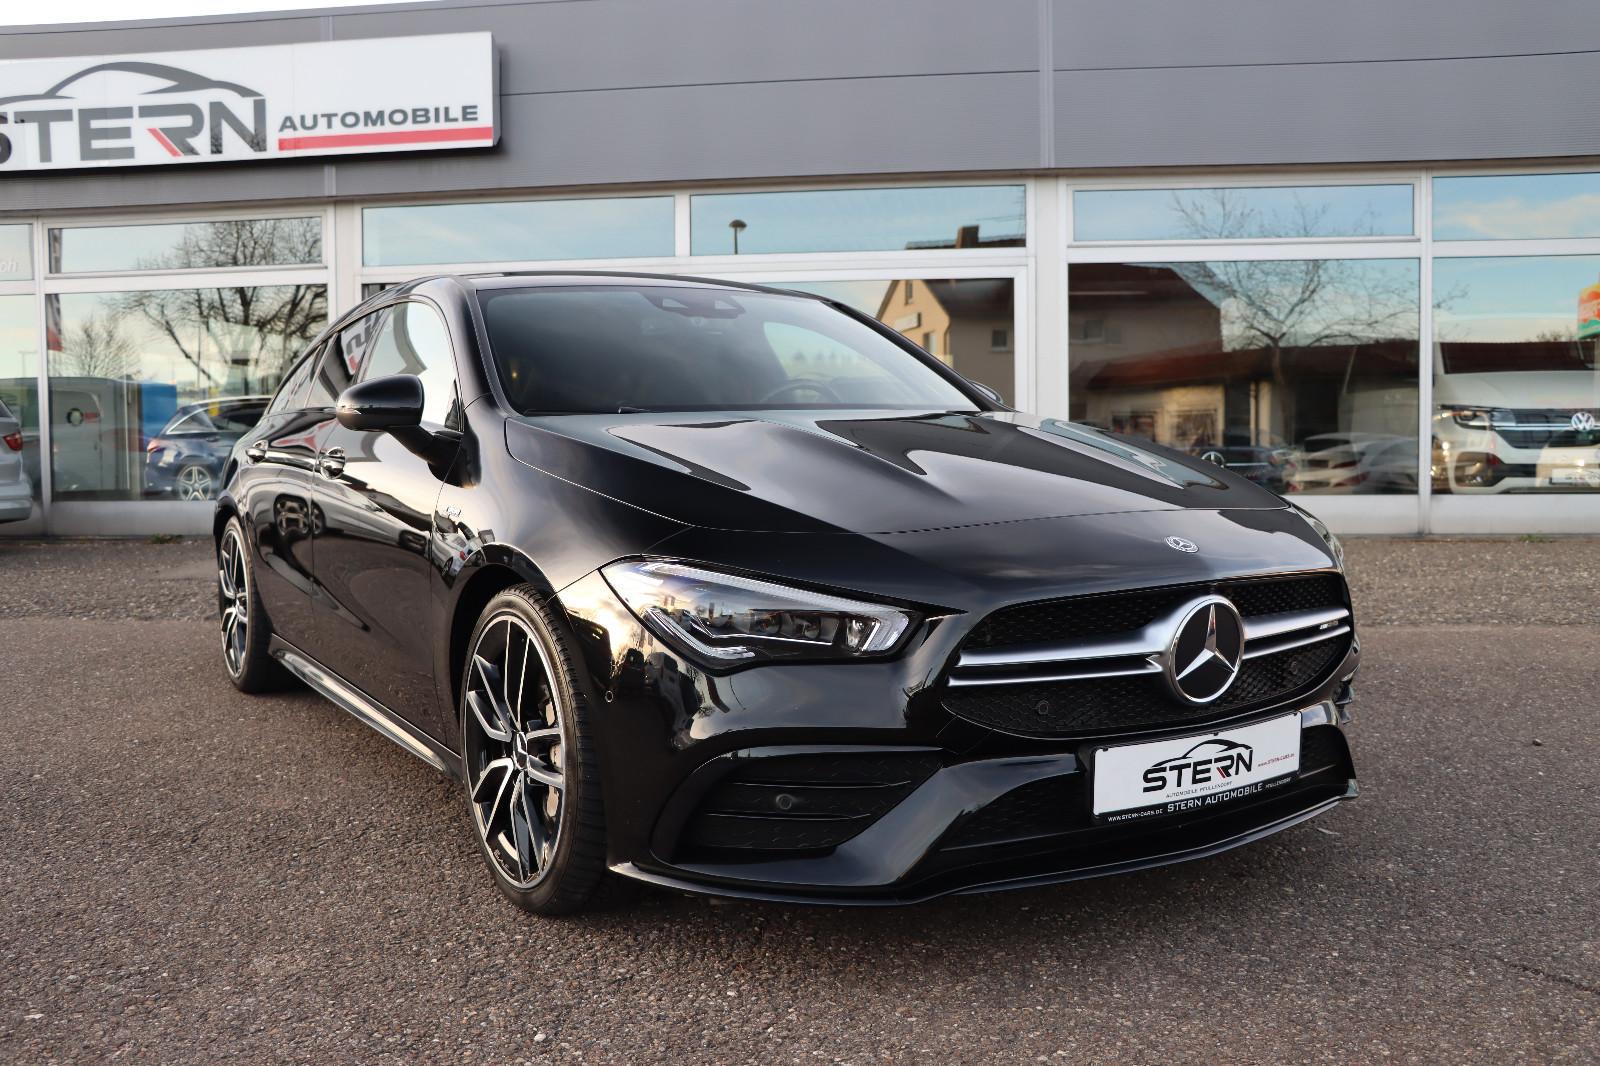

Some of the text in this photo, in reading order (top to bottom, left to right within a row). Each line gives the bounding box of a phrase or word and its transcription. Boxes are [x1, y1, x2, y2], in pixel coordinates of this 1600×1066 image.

[0, 98, 479, 165] TERN AUTOMOBILE
[1142, 749, 1254, 793] STERN
[1168, 797, 1202, 812] STERN
[1205, 783, 1263, 805] AUTOMOBILE
